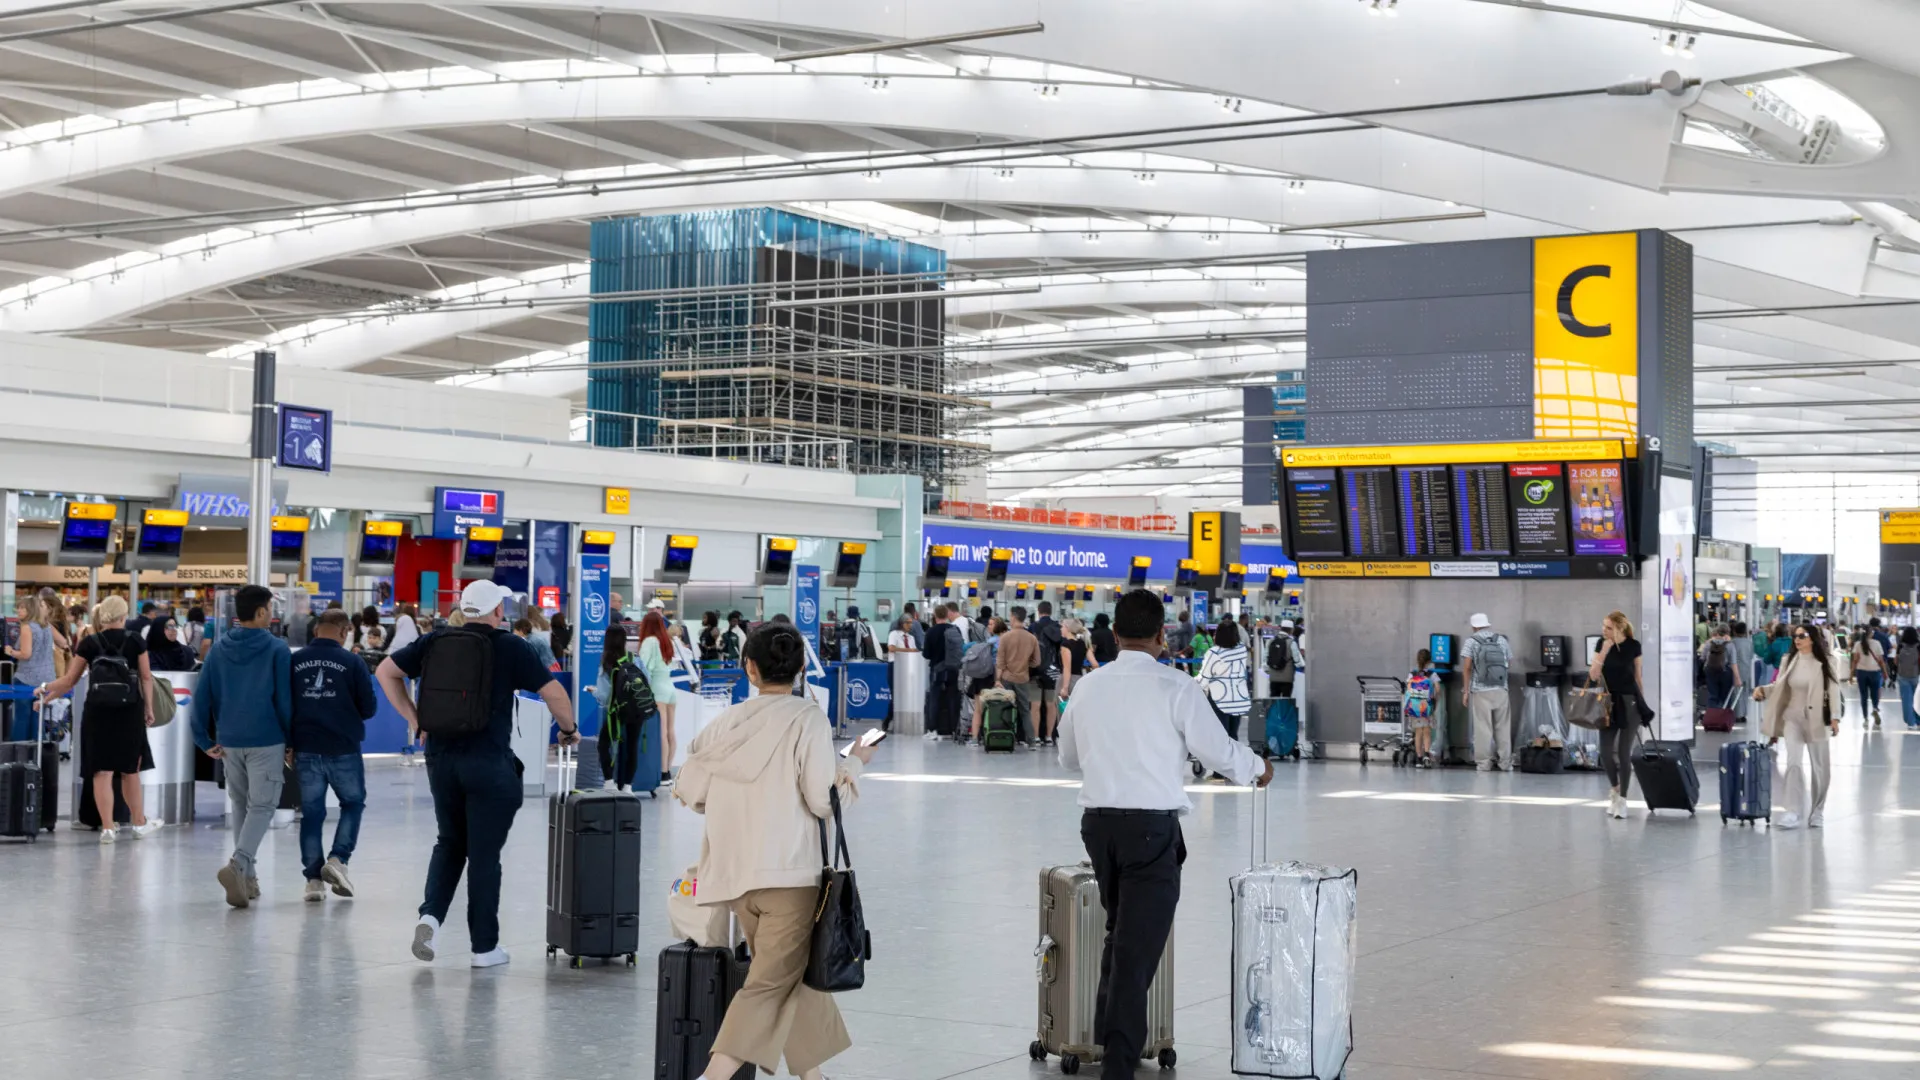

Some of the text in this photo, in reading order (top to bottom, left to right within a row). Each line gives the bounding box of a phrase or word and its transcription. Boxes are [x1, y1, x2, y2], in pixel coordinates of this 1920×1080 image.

[1556, 264, 1612, 338] C
[1338, 450, 1391, 461] information
[1571, 467, 1618, 478] 2 FOR £90
[456, 514, 485, 526] Currency
[1201, 521, 1213, 541] E
[1028, 547, 1043, 566] to
[1045, 550, 1067, 568] our
[1069, 545, 1109, 569] home.
[1516, 562, 1547, 570] Assistance
[177, 568, 235, 580] BESTSELLING
[294, 659, 347, 672] AMALFI COAST
